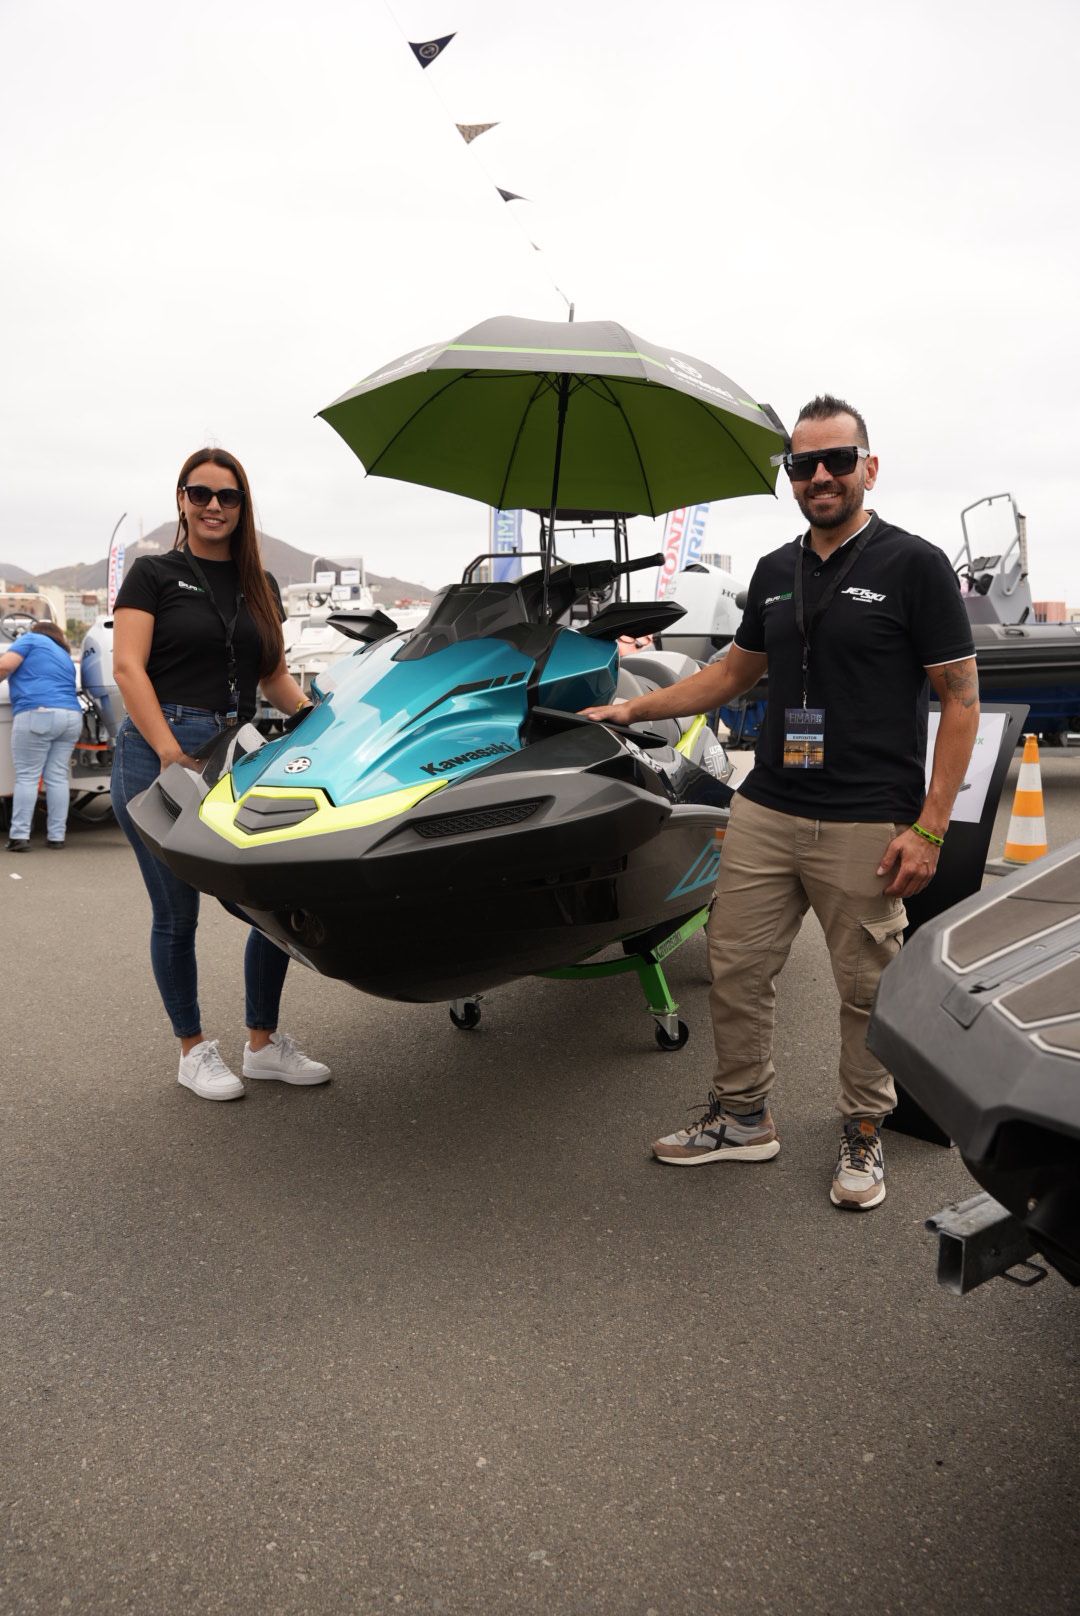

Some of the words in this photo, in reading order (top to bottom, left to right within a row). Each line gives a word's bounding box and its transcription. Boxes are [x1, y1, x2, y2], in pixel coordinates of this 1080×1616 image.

[497, 509, 514, 554] FIMA
[657, 503, 687, 599] HOND
[419, 741, 517, 776] Kawasaki
